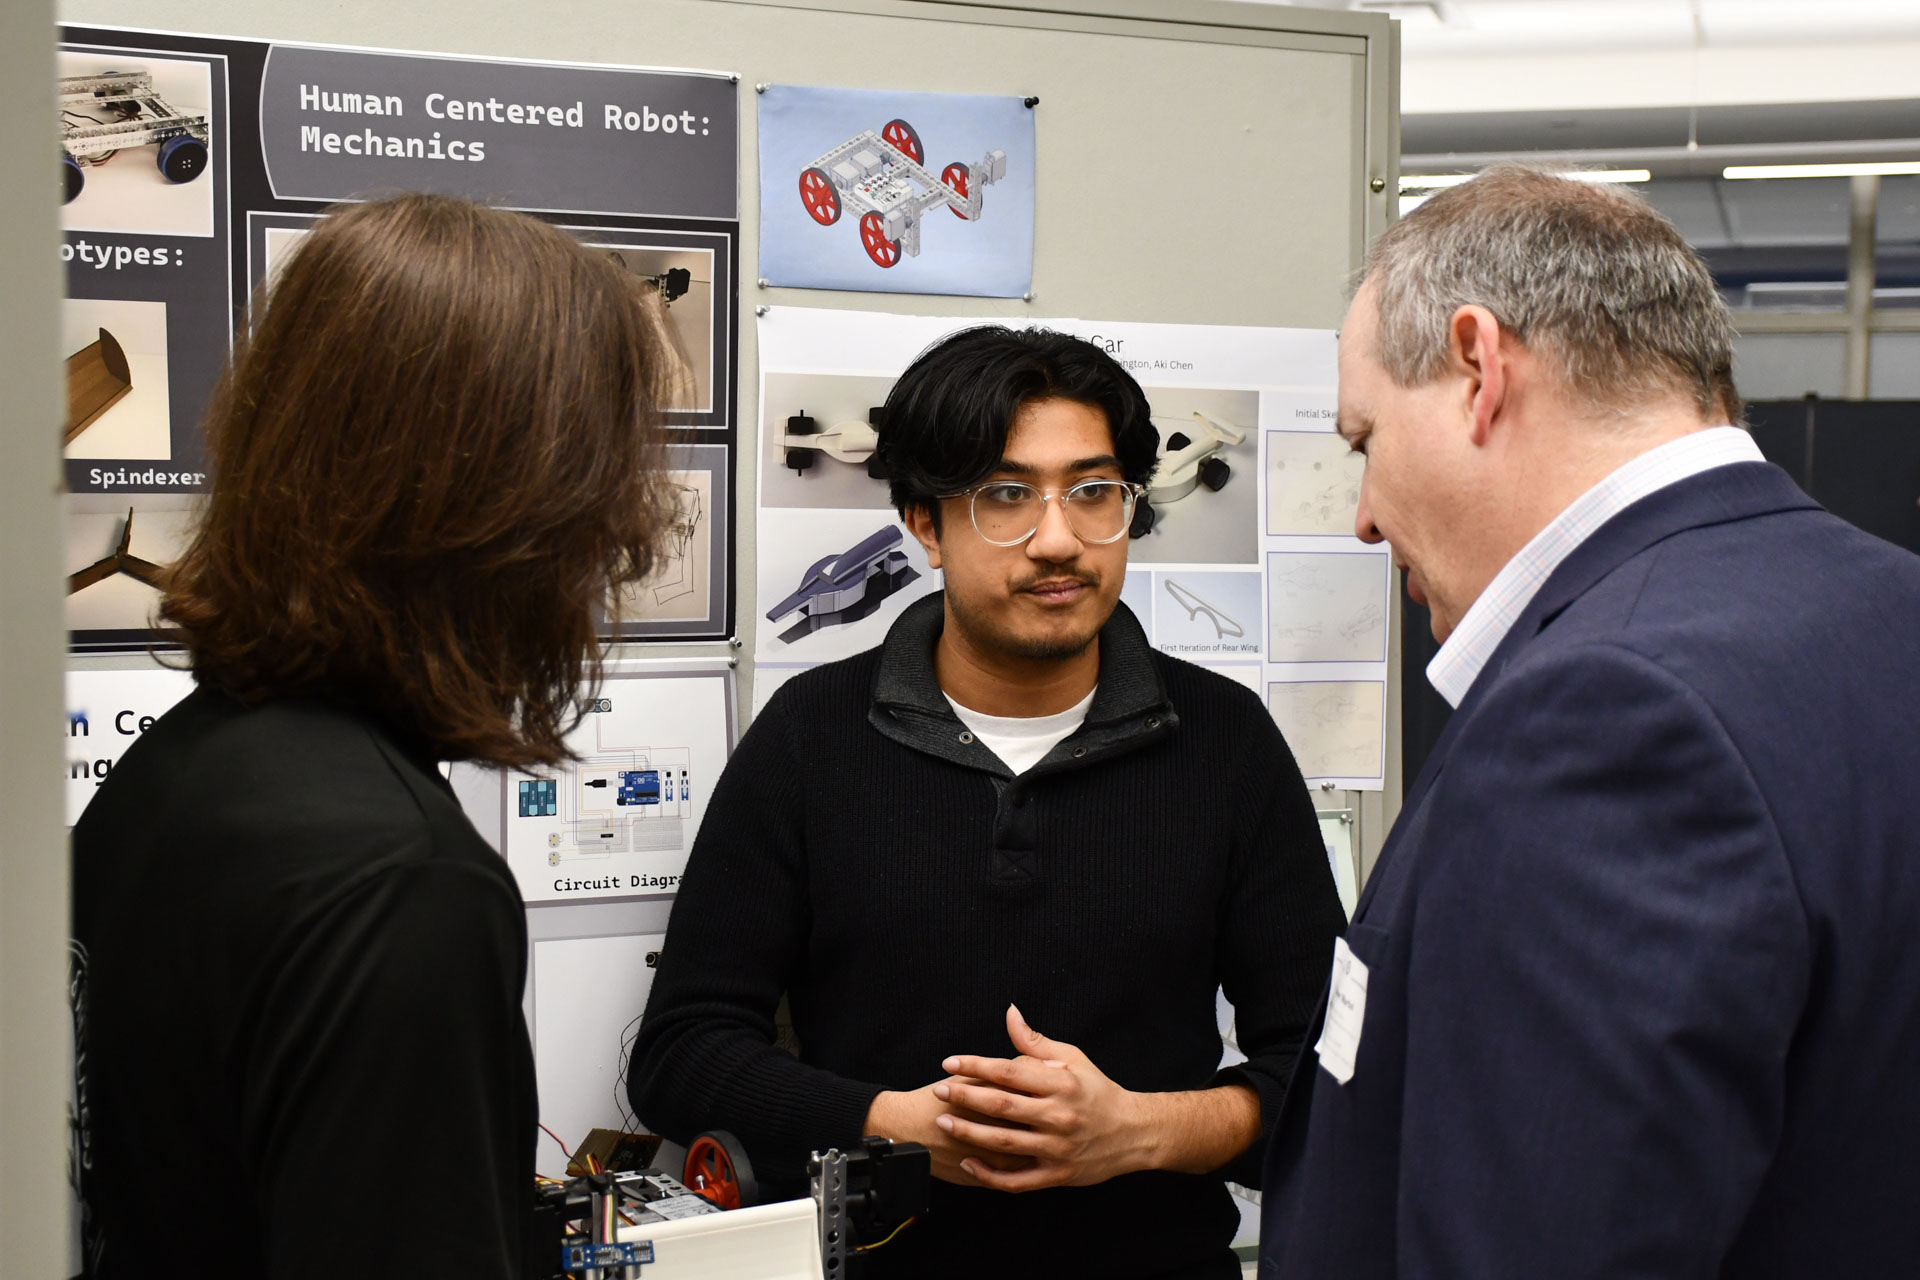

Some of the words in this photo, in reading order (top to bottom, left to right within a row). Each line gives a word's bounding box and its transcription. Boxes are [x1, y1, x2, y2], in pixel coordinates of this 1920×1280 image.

[300, 84, 403, 117] Human
[425, 93, 583, 128] Centered
[604, 104, 710, 136] Robot:
[301, 125, 486, 162] Mechanics
[1091, 334, 1125, 353] Car
[1154, 360, 1167, 369] Aki
[1169, 360, 1193, 370] Chen
[1295, 409, 1320, 419] Initial
[90, 467, 206, 489] Spindexer
[1160, 644, 1177, 652] First
[1179, 644, 1211, 652] Iteration
[1212, 644, 1221, 652] of
[1240, 644, 1259, 653] Wing
[554, 876, 621, 892] Circuit
